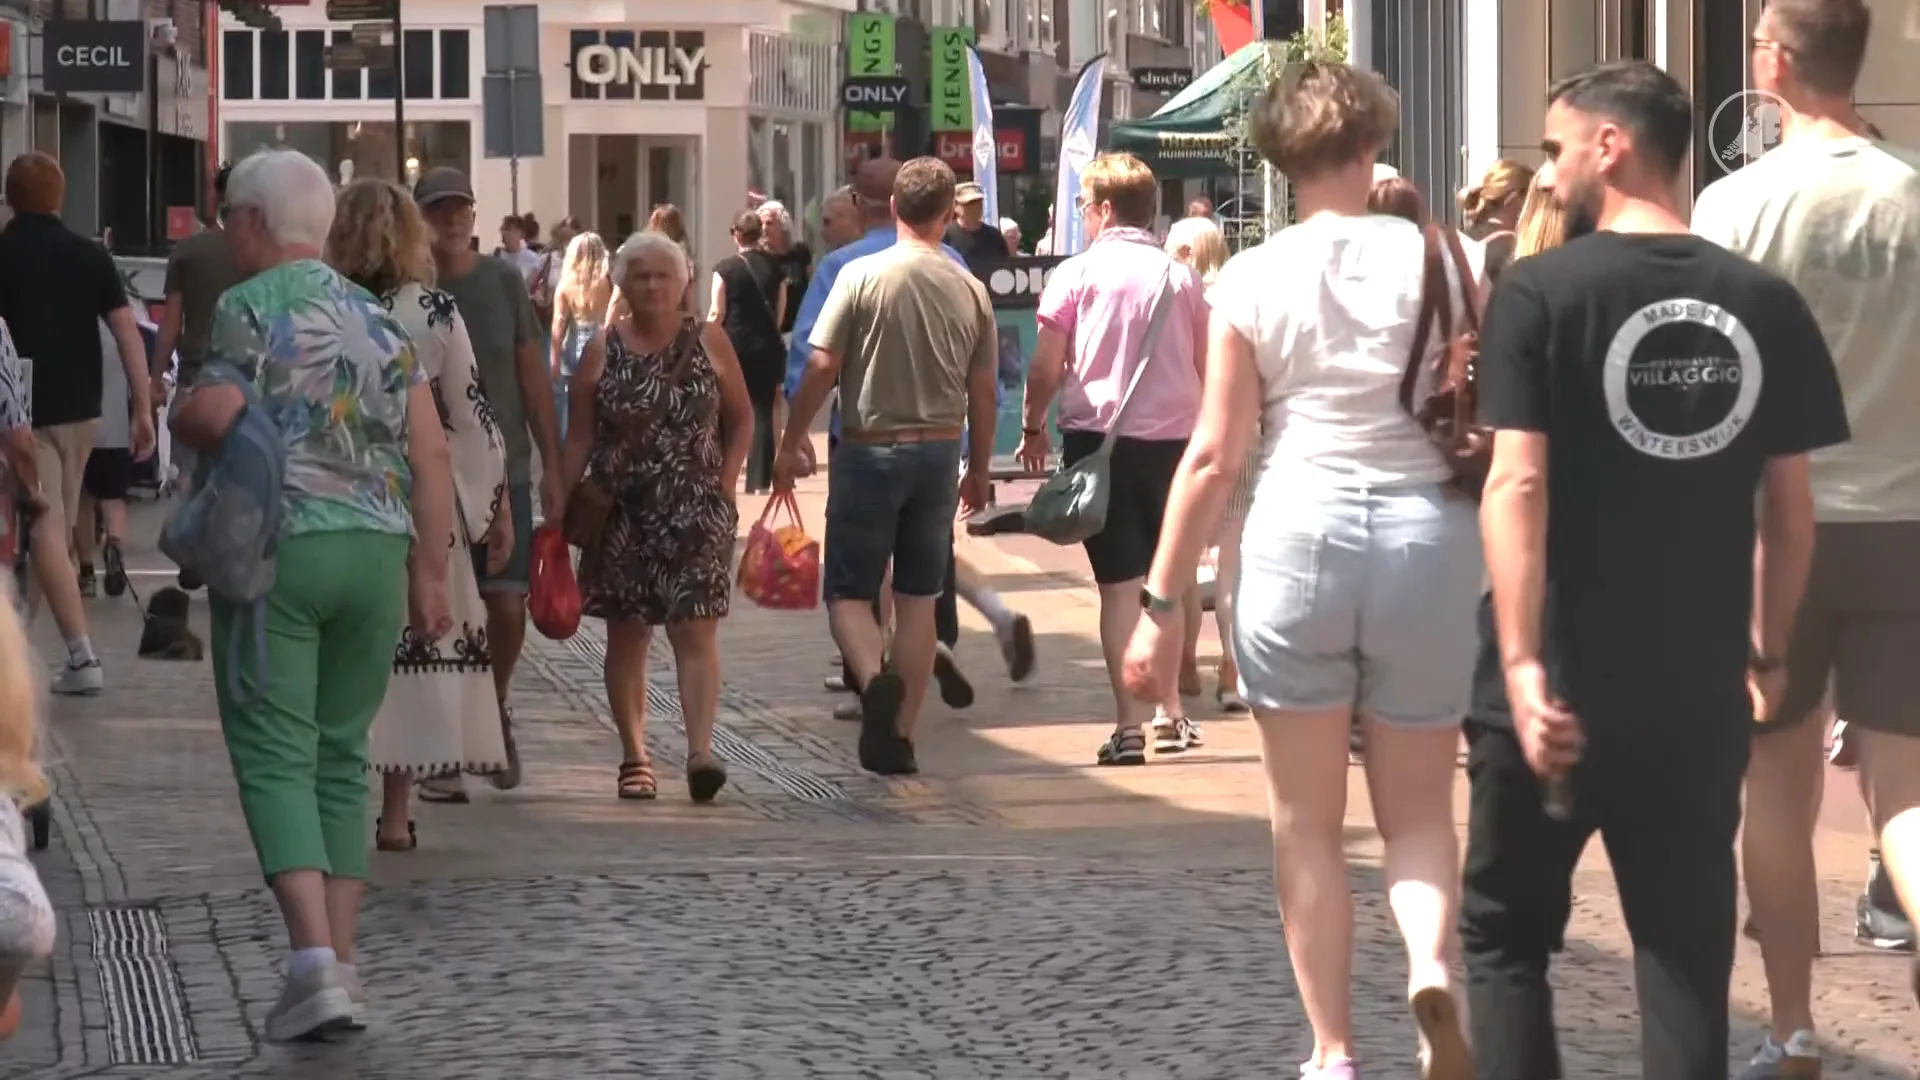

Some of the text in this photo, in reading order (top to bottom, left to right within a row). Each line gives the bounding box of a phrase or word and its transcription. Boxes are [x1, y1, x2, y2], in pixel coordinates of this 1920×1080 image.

[57, 45, 130, 67] CECIL
[576, 44, 706, 85] ONLY
[944, 32, 961, 126] ZIENGS
[845, 85, 907, 102] ONLY
[1643, 303, 1697, 325] MADE
[1629, 366, 1741, 387] VILLAGGIO
[1618, 413, 1743, 454] WINTERSWIJK
